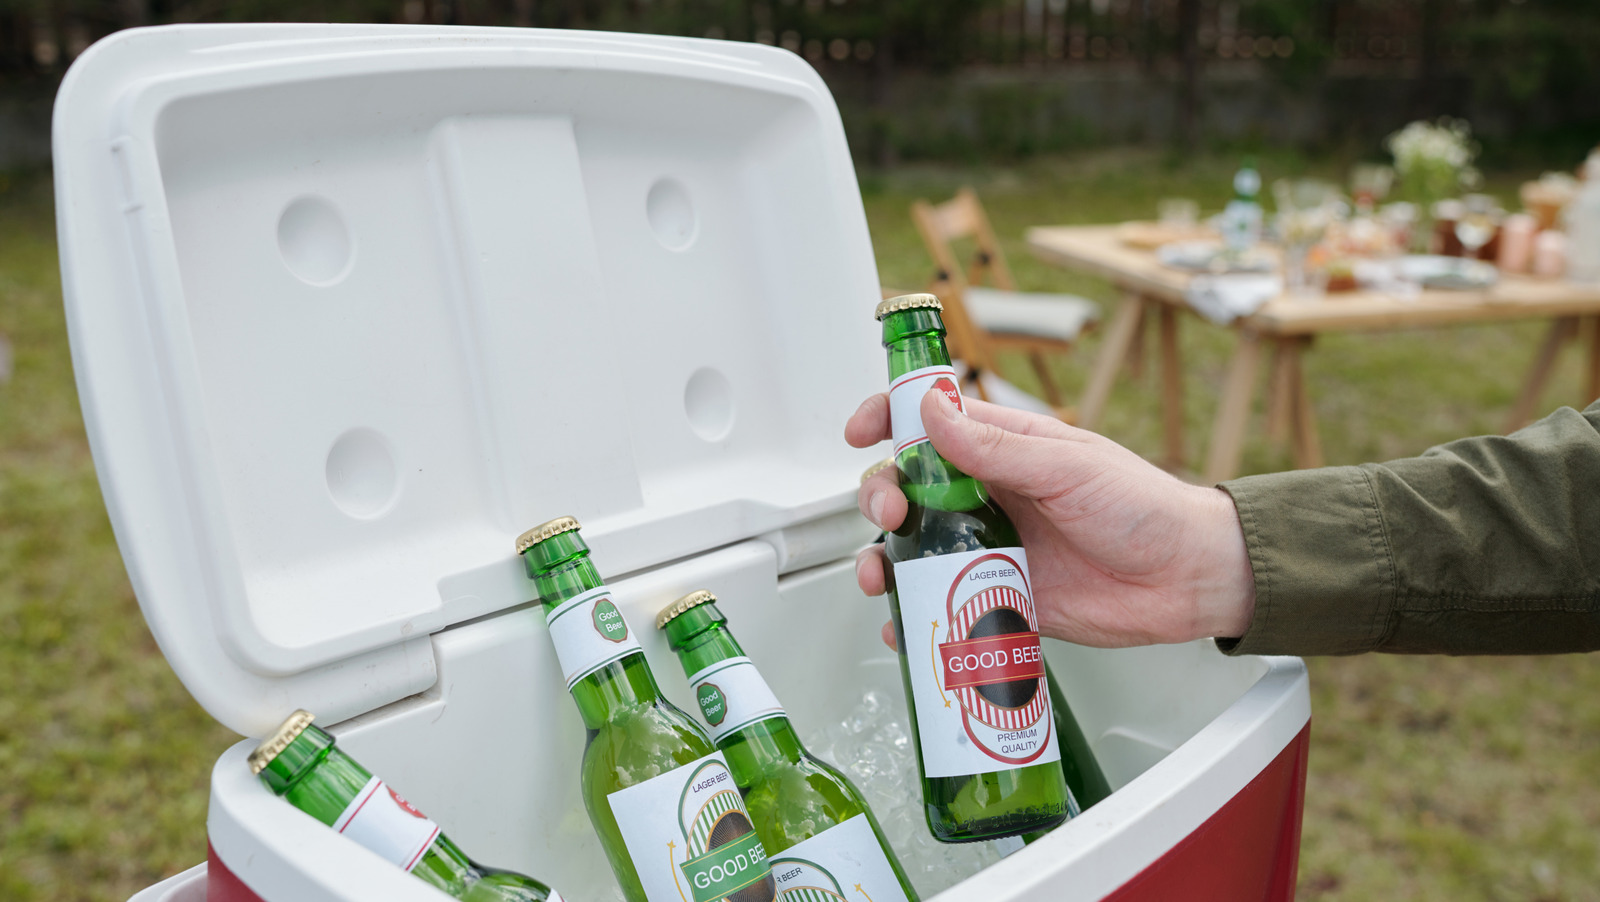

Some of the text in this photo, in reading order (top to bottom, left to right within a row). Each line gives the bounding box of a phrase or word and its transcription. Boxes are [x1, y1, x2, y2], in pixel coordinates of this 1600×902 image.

[944, 389, 956, 398] ood
[969, 568, 1017, 581] LAGER BEER
[598, 609, 618, 622] Good
[605, 621, 623, 632] Beer
[948, 650, 1008, 673] GOOD
[700, 691, 718, 706] Good
[705, 703, 721, 717] Beer
[997, 729, 1038, 743] PREMIUM
[1001, 740, 1038, 754] QUALITY
[692, 771, 728, 793] LAGER BEER
[694, 854, 747, 889] GOOD
[782, 867, 803, 882] BEER
